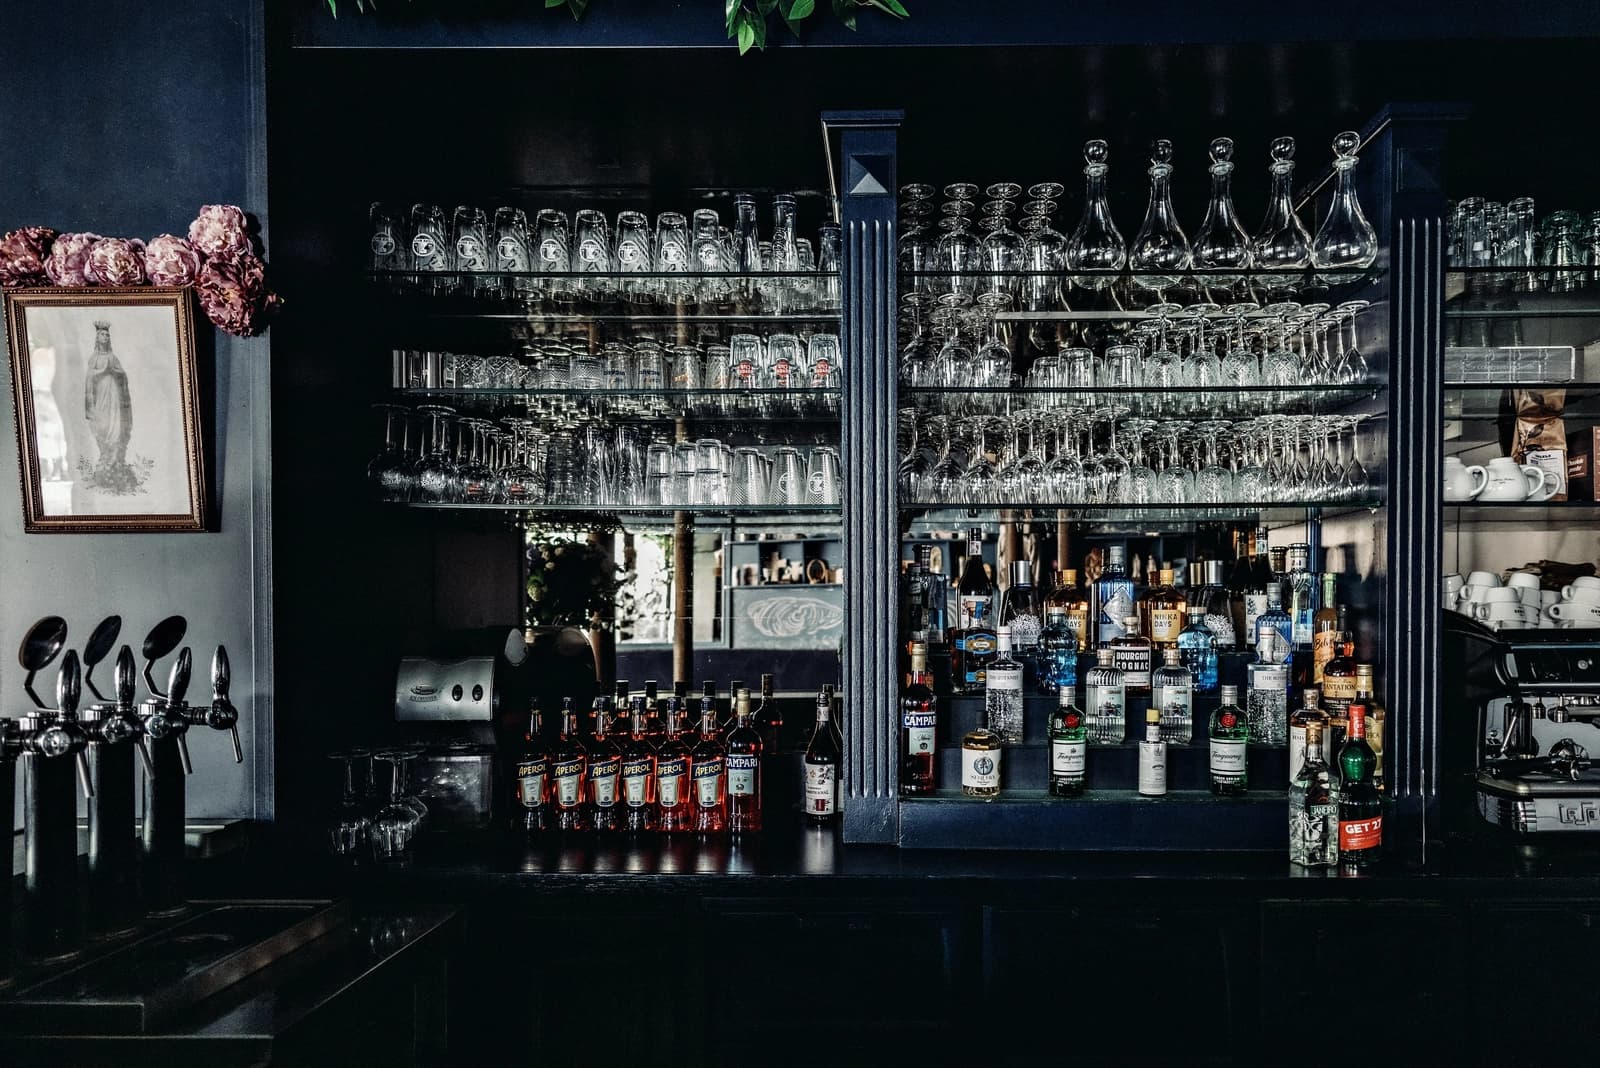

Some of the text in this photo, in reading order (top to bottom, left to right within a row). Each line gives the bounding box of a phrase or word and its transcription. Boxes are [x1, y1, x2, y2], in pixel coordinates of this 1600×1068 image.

[1116, 662, 1149, 670] COGNAC
[623, 763, 651, 777] APEROL
[695, 763, 722, 777] APEROL
[1345, 818, 1383, 834] GET 27
